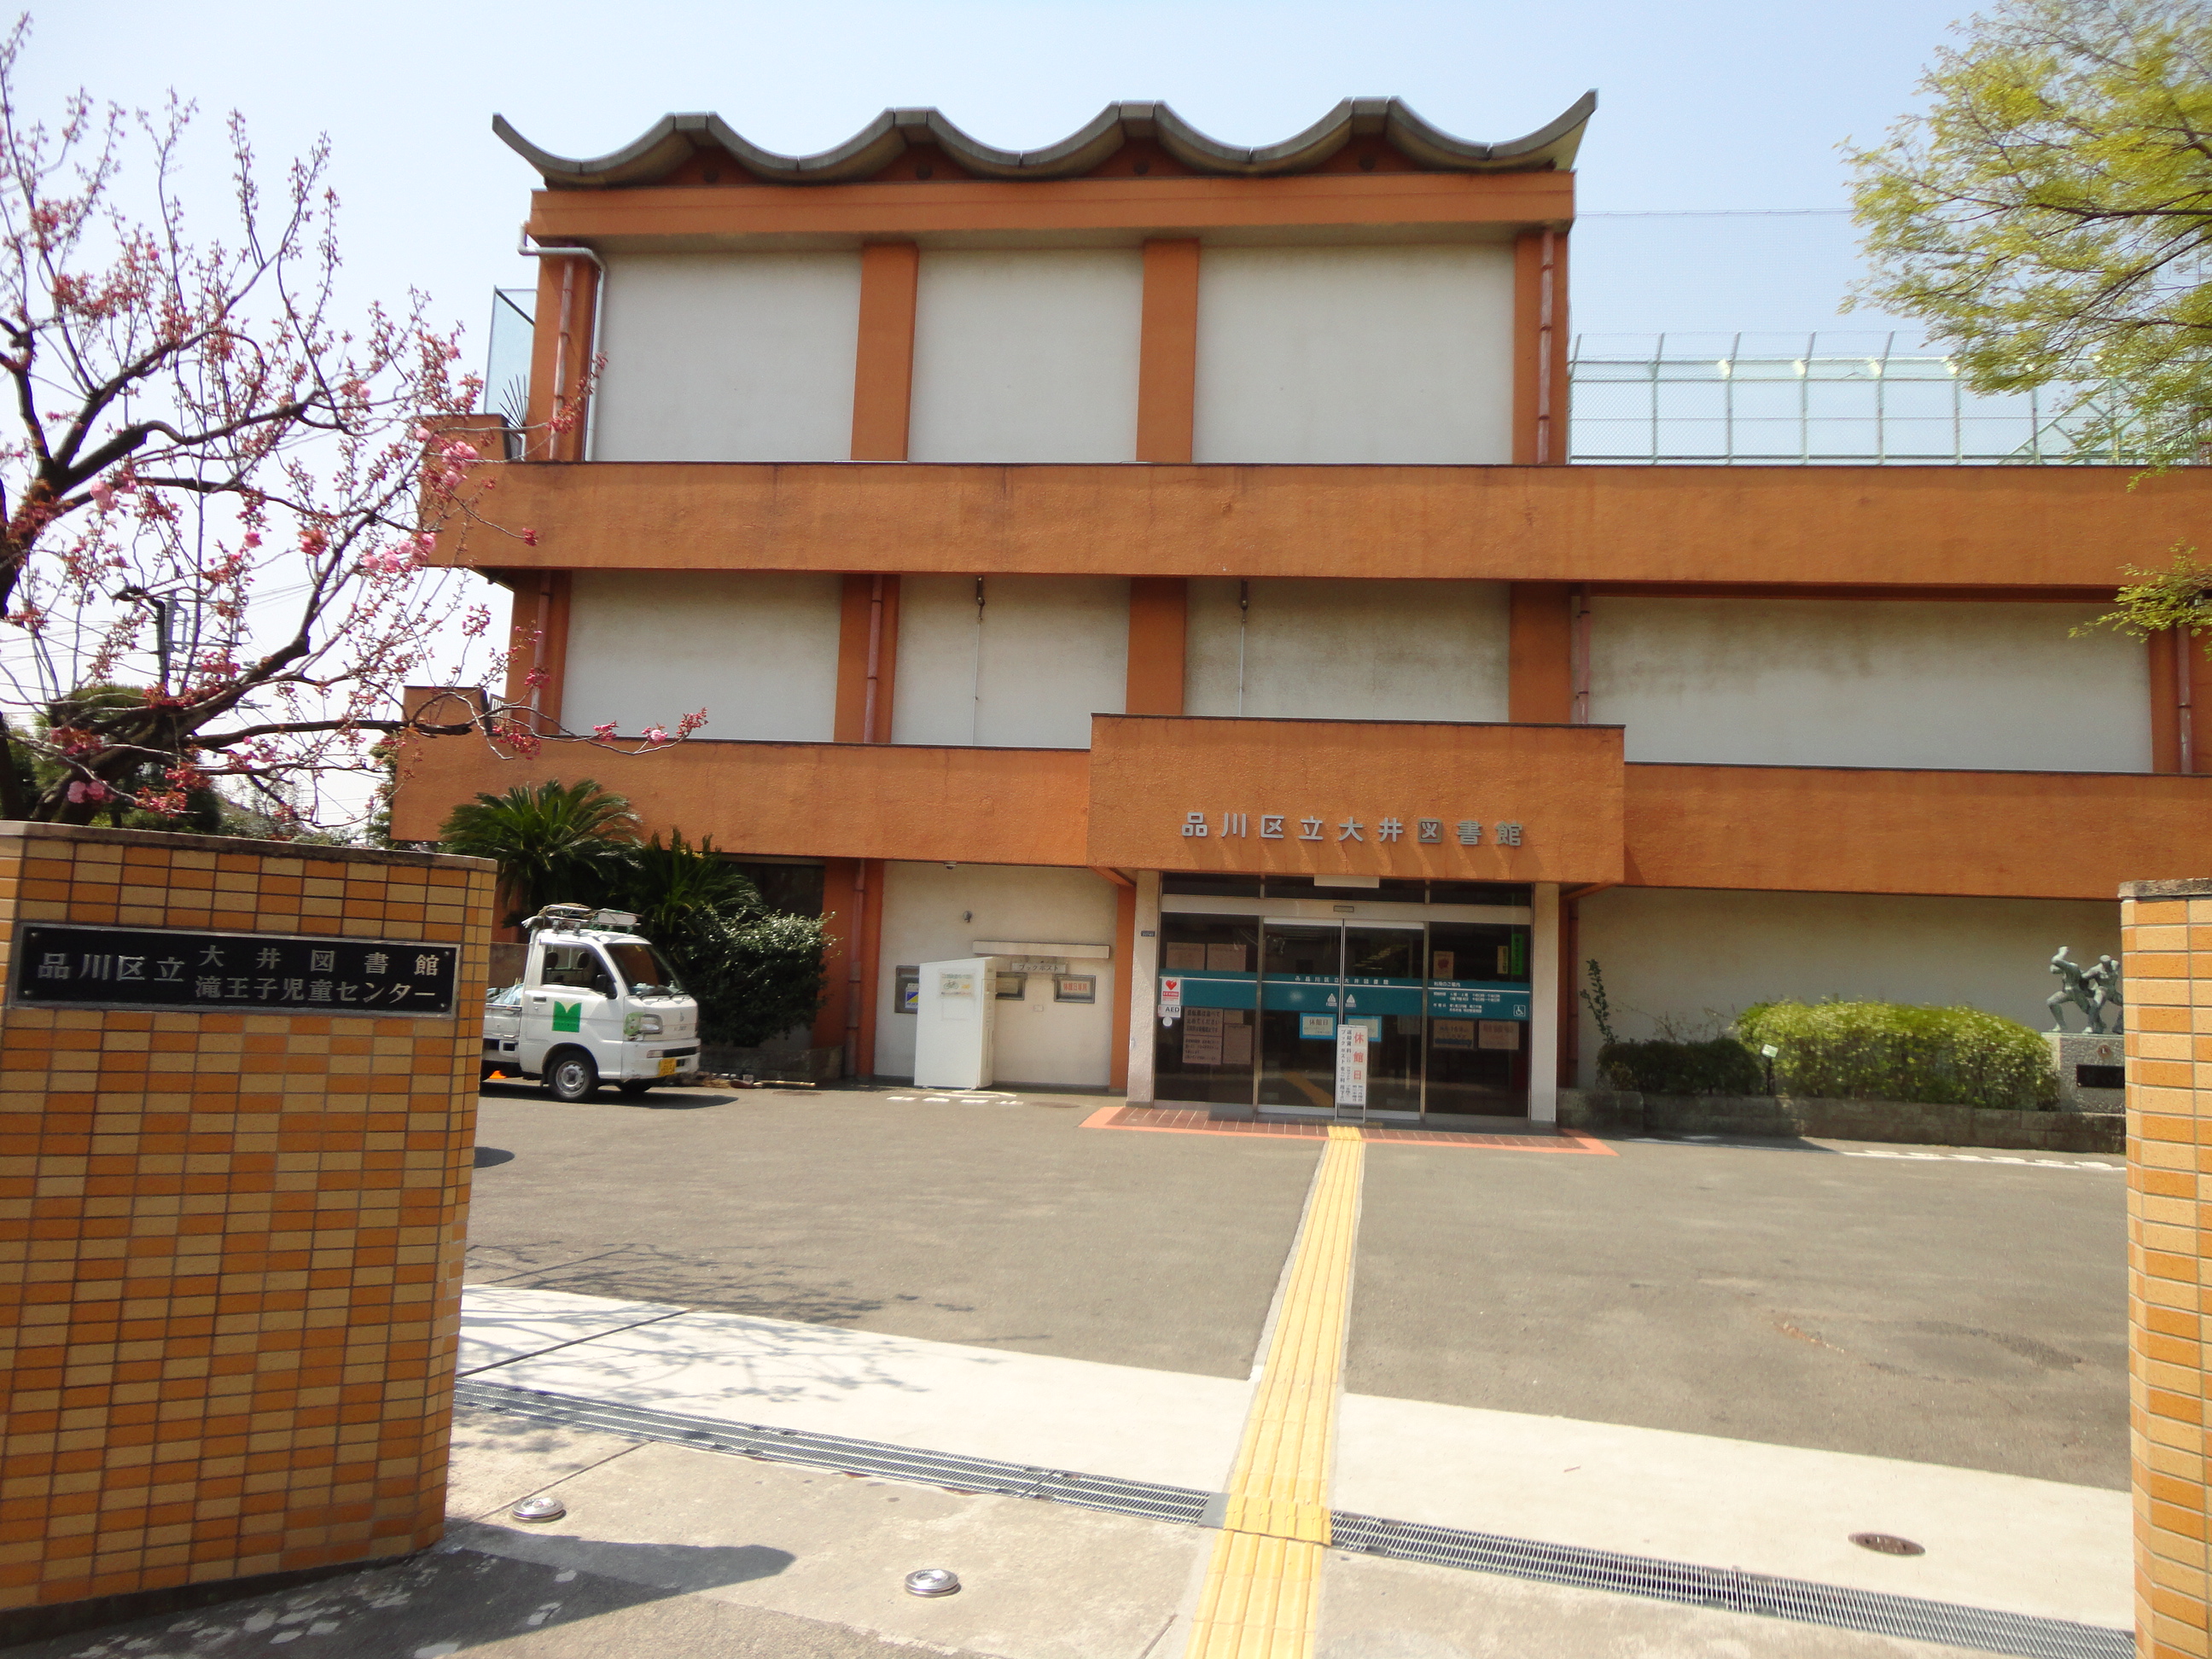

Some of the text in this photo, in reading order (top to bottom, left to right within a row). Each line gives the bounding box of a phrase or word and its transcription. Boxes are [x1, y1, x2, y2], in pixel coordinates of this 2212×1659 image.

[1181, 812, 1523, 847] 品川区立大井図書館
[38, 952, 185, 983] 品川区立
[198, 944, 439, 976] 大井図書館
[195, 975, 436, 1003] 滝王子児童センター
[1353, 1032, 1365, 1080] 休館日
